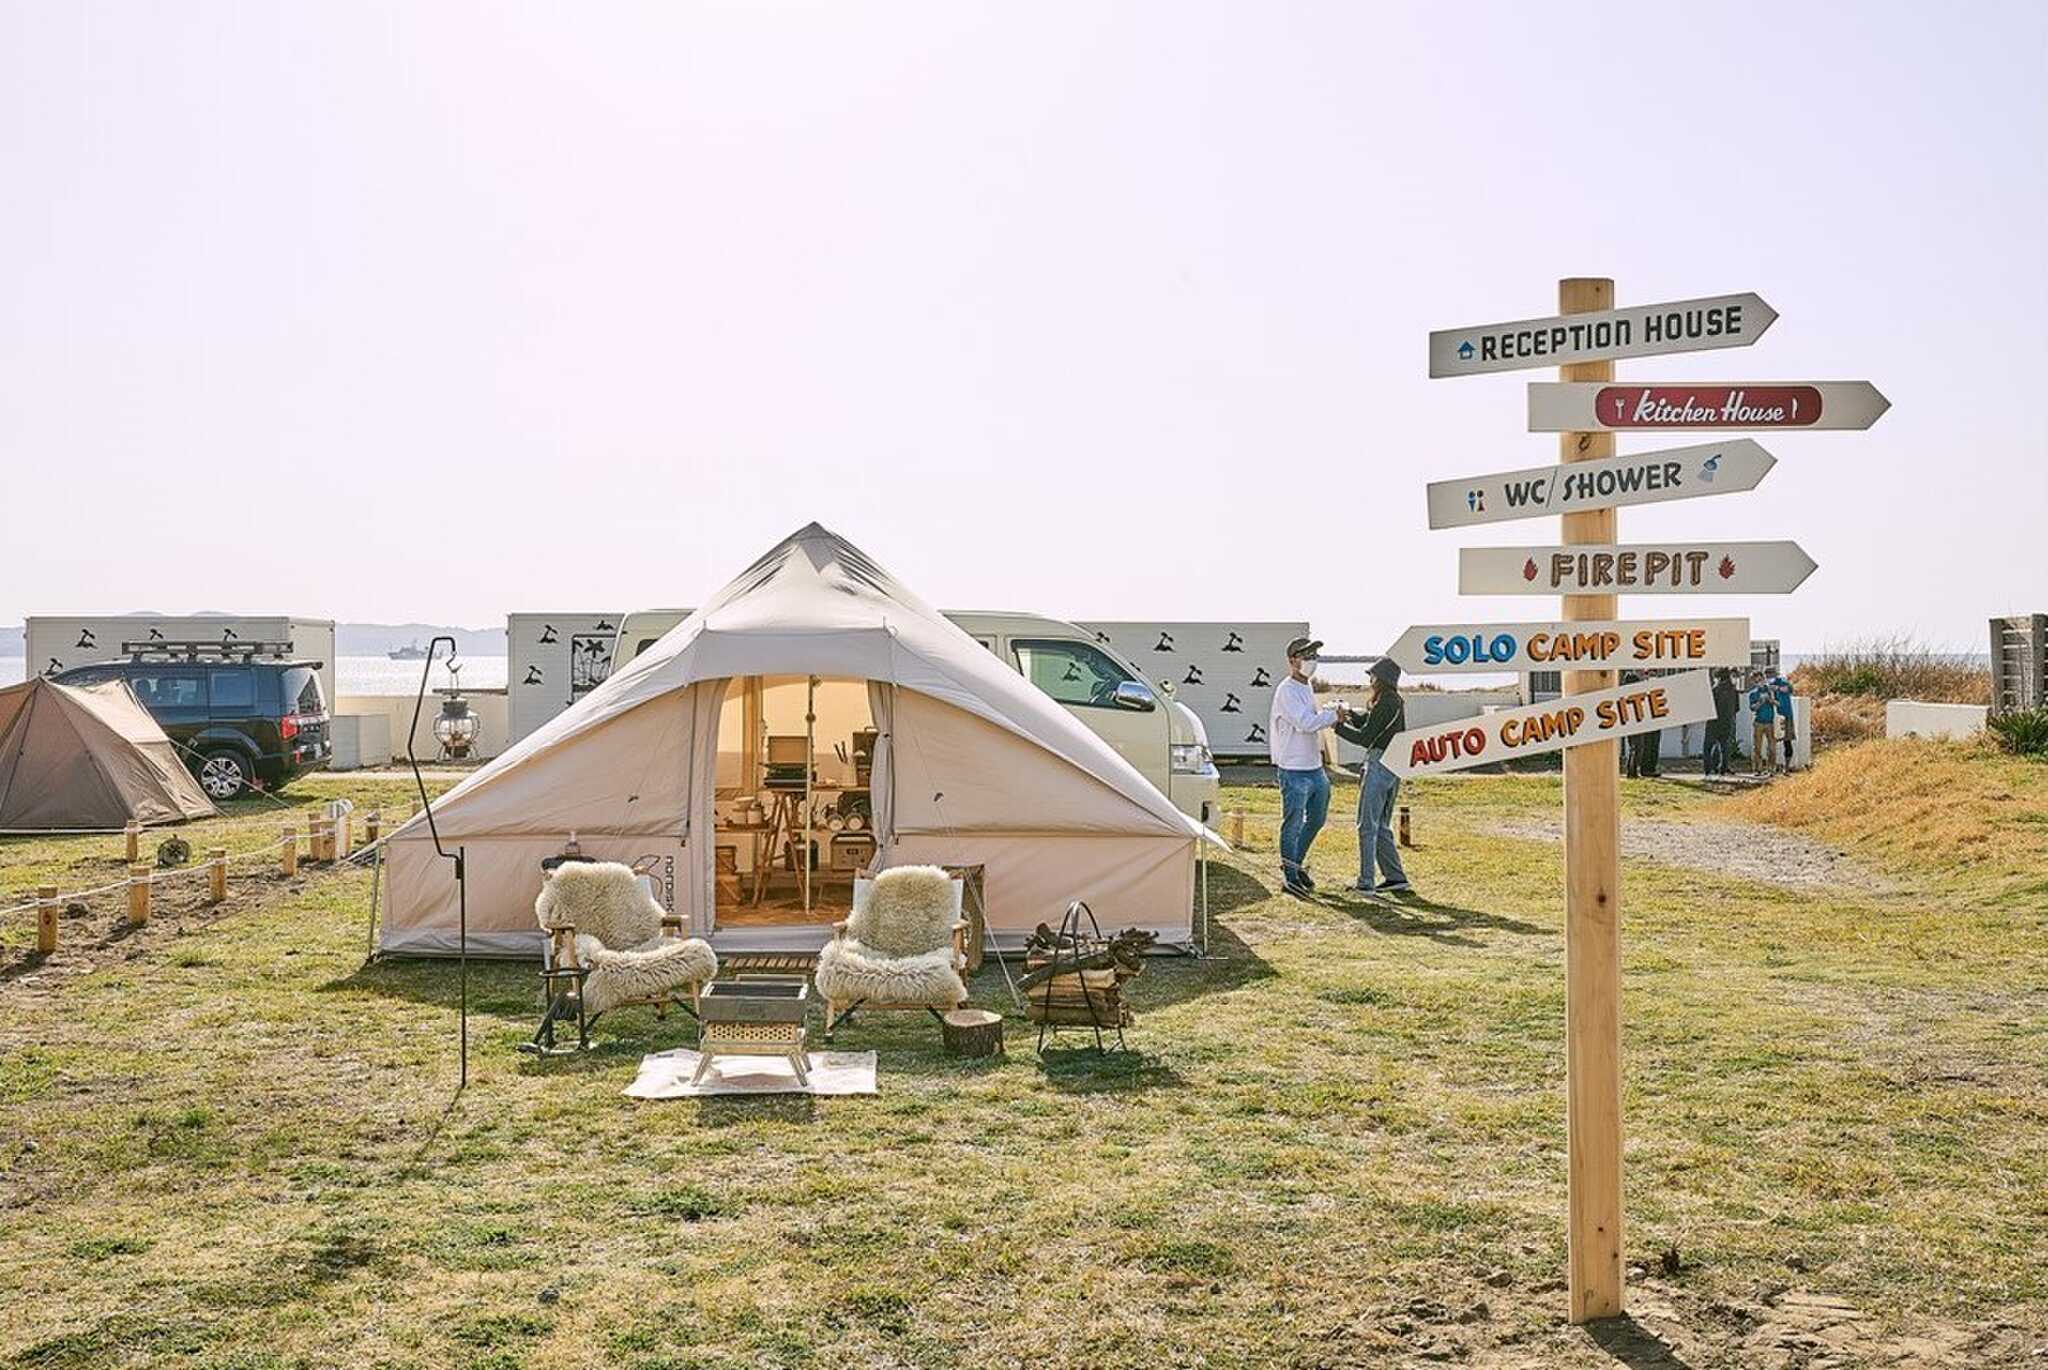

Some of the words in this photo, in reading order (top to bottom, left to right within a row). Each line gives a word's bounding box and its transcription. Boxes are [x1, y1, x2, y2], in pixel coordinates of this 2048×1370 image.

[1481, 319, 1632, 361] RECEPTION
[1645, 305, 1742, 343] HOUSE
[1720, 390, 1786, 422] House
[1423, 633, 1517, 666] SOLO
[1527, 631, 1620, 663] CAMP
[1633, 628, 1707, 660] SITE
[1410, 726, 1487, 767] AUTO
[1500, 705, 1585, 749] CAMP
[1597, 688, 1671, 729] SITE
